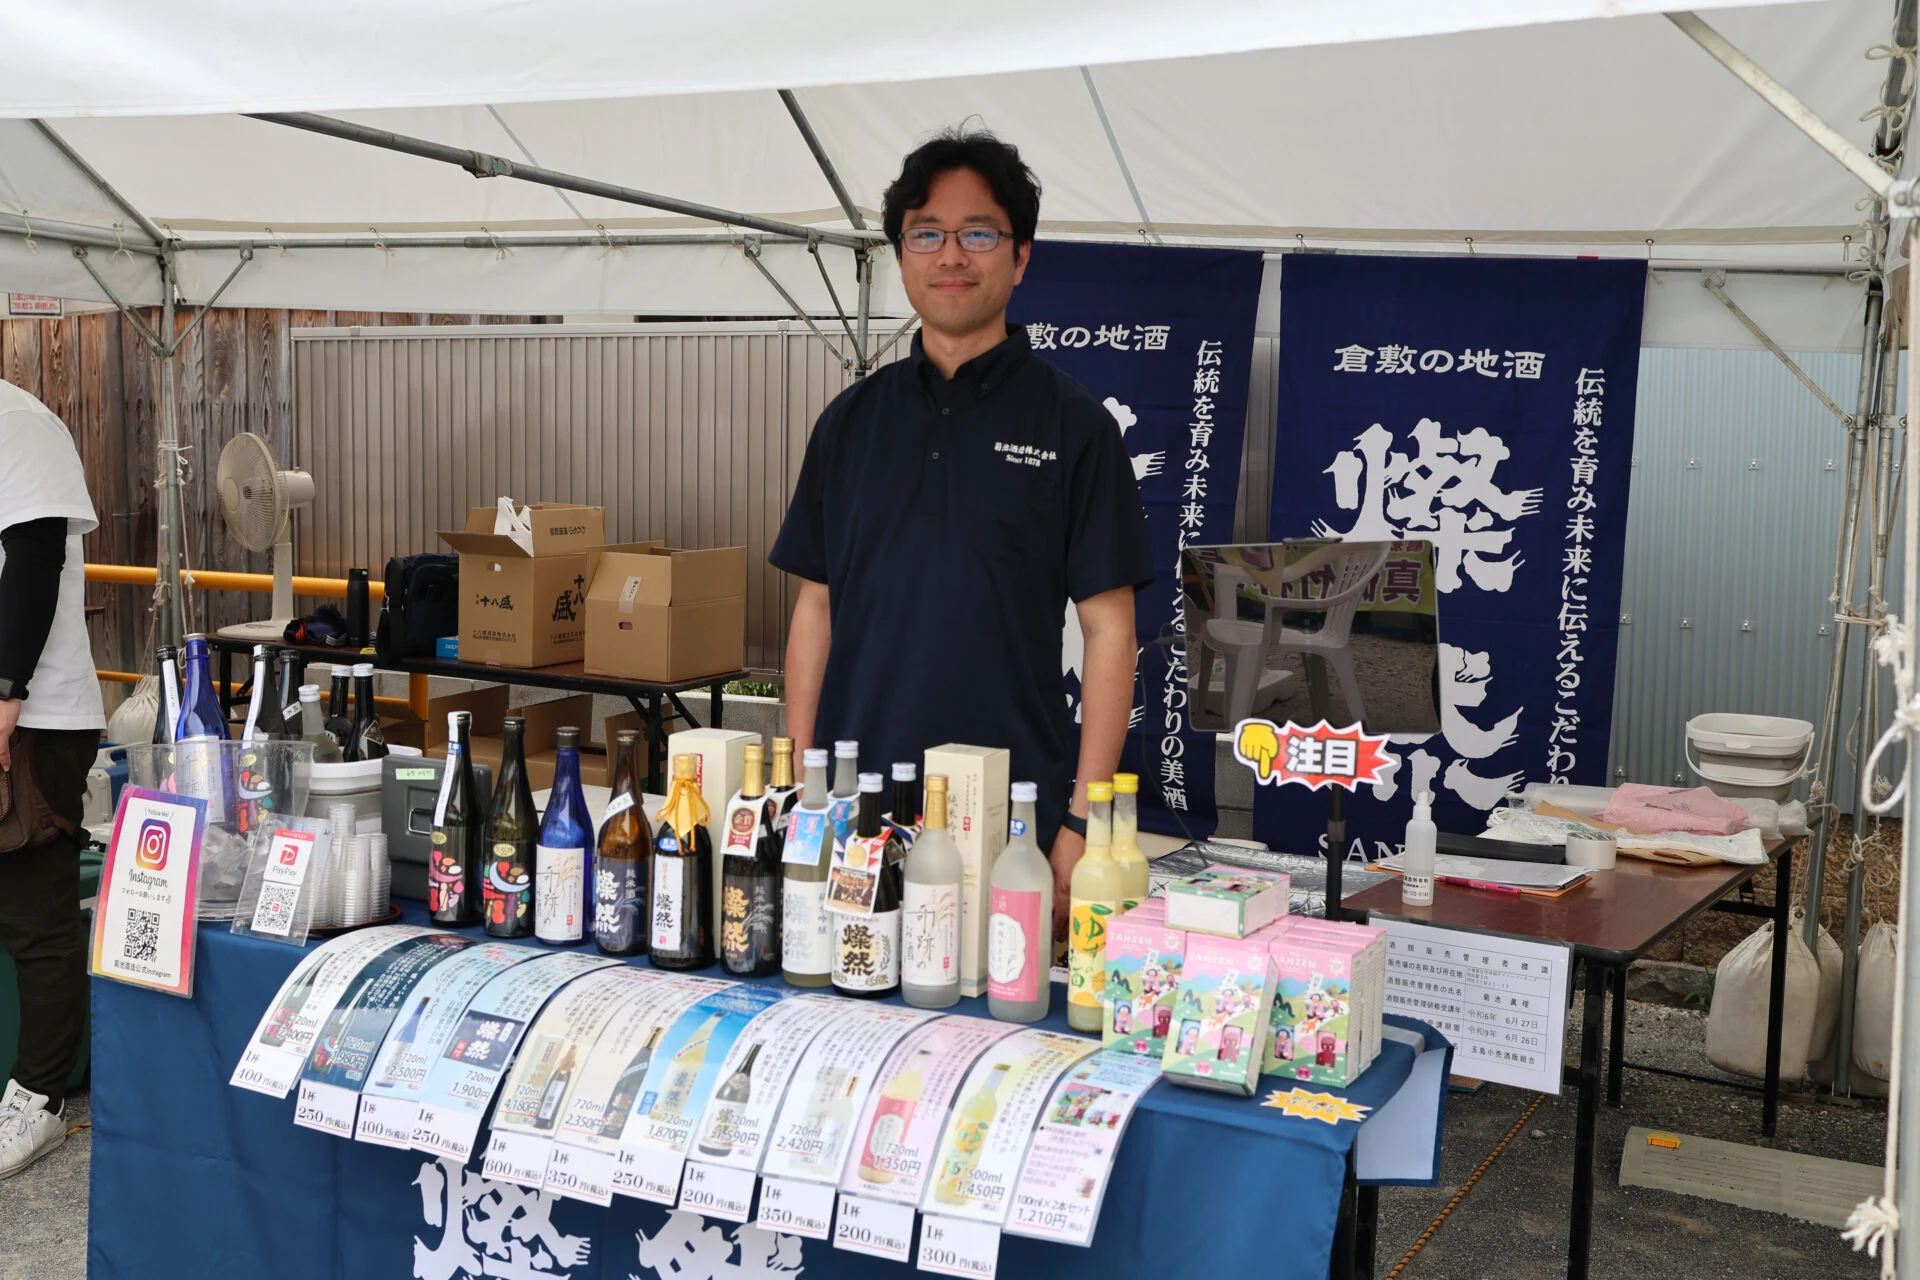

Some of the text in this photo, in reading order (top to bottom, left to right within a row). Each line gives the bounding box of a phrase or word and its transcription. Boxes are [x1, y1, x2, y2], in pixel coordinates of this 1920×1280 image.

[1333, 344, 1545, 380] 倉敷の地酒
[1285, 737, 1357, 778] 注目
[128, 868, 168, 891] Instagram
[272, 865, 298, 877] PayPay
[625, 869, 637, 899] 純米酒
[842, 923, 875, 976] 燦然
[1467, 1009, 1539, 1029] 令和6年 6月 27日
[343, 1036, 375, 1052] 720ml
[1467, 1025, 1539, 1046] 令和9年 6月 26日
[245, 1051, 261, 1064] 1杯
[331, 1051, 367, 1069] 1,980円
[402, 1051, 428, 1065] 720ml
[236, 1069, 262, 1084] 400
[389, 1065, 427, 1082] 2,500円
[465, 1070, 496, 1085] 720ml
[300, 1088, 317, 1102] 1杯
[452, 1082, 491, 1100] 1,900円
[514, 1084, 543, 1098] 720ml
[361, 1101, 377, 1115] 1杯
[503, 1098, 539, 1114] 4,180円
[573, 1098, 605, 1113] 720ml
[297, 1106, 324, 1123] 250
[417, 1108, 434, 1123] 1杯
[661, 1112, 694, 1128] 720ml
[358, 1119, 384, 1135] 400
[648, 1124, 688, 1144] 1,870円
[788, 1123, 822, 1138] 720ml
[411, 1127, 440, 1146] 250
[490, 1138, 507, 1152] 1杯
[776, 1136, 824, 1155] 2,420円
[885, 1143, 919, 1158] 720ml
[551, 1149, 569, 1164] 1杯
[617, 1150, 635, 1164] 1杯
[873, 1155, 922, 1174] 1,350円
[485, 1160, 512, 1176] 600
[687, 1168, 705, 1183] 1杯
[969, 1170, 1004, 1183] 500ml
[548, 1169, 578, 1188] 350
[612, 1170, 645, 1189] 250
[683, 1188, 714, 1206] 200
[764, 1184, 782, 1200] 1杯
[956, 1181, 1006, 1201] 1,450円
[760, 1206, 793, 1225] 350
[841, 1200, 861, 1217] 1杯
[1017, 1208, 1068, 1229] 1,210円
[838, 1223, 871, 1243] 200
[925, 1223, 945, 1240] 1杯
[922, 1247, 957, 1267] 300
